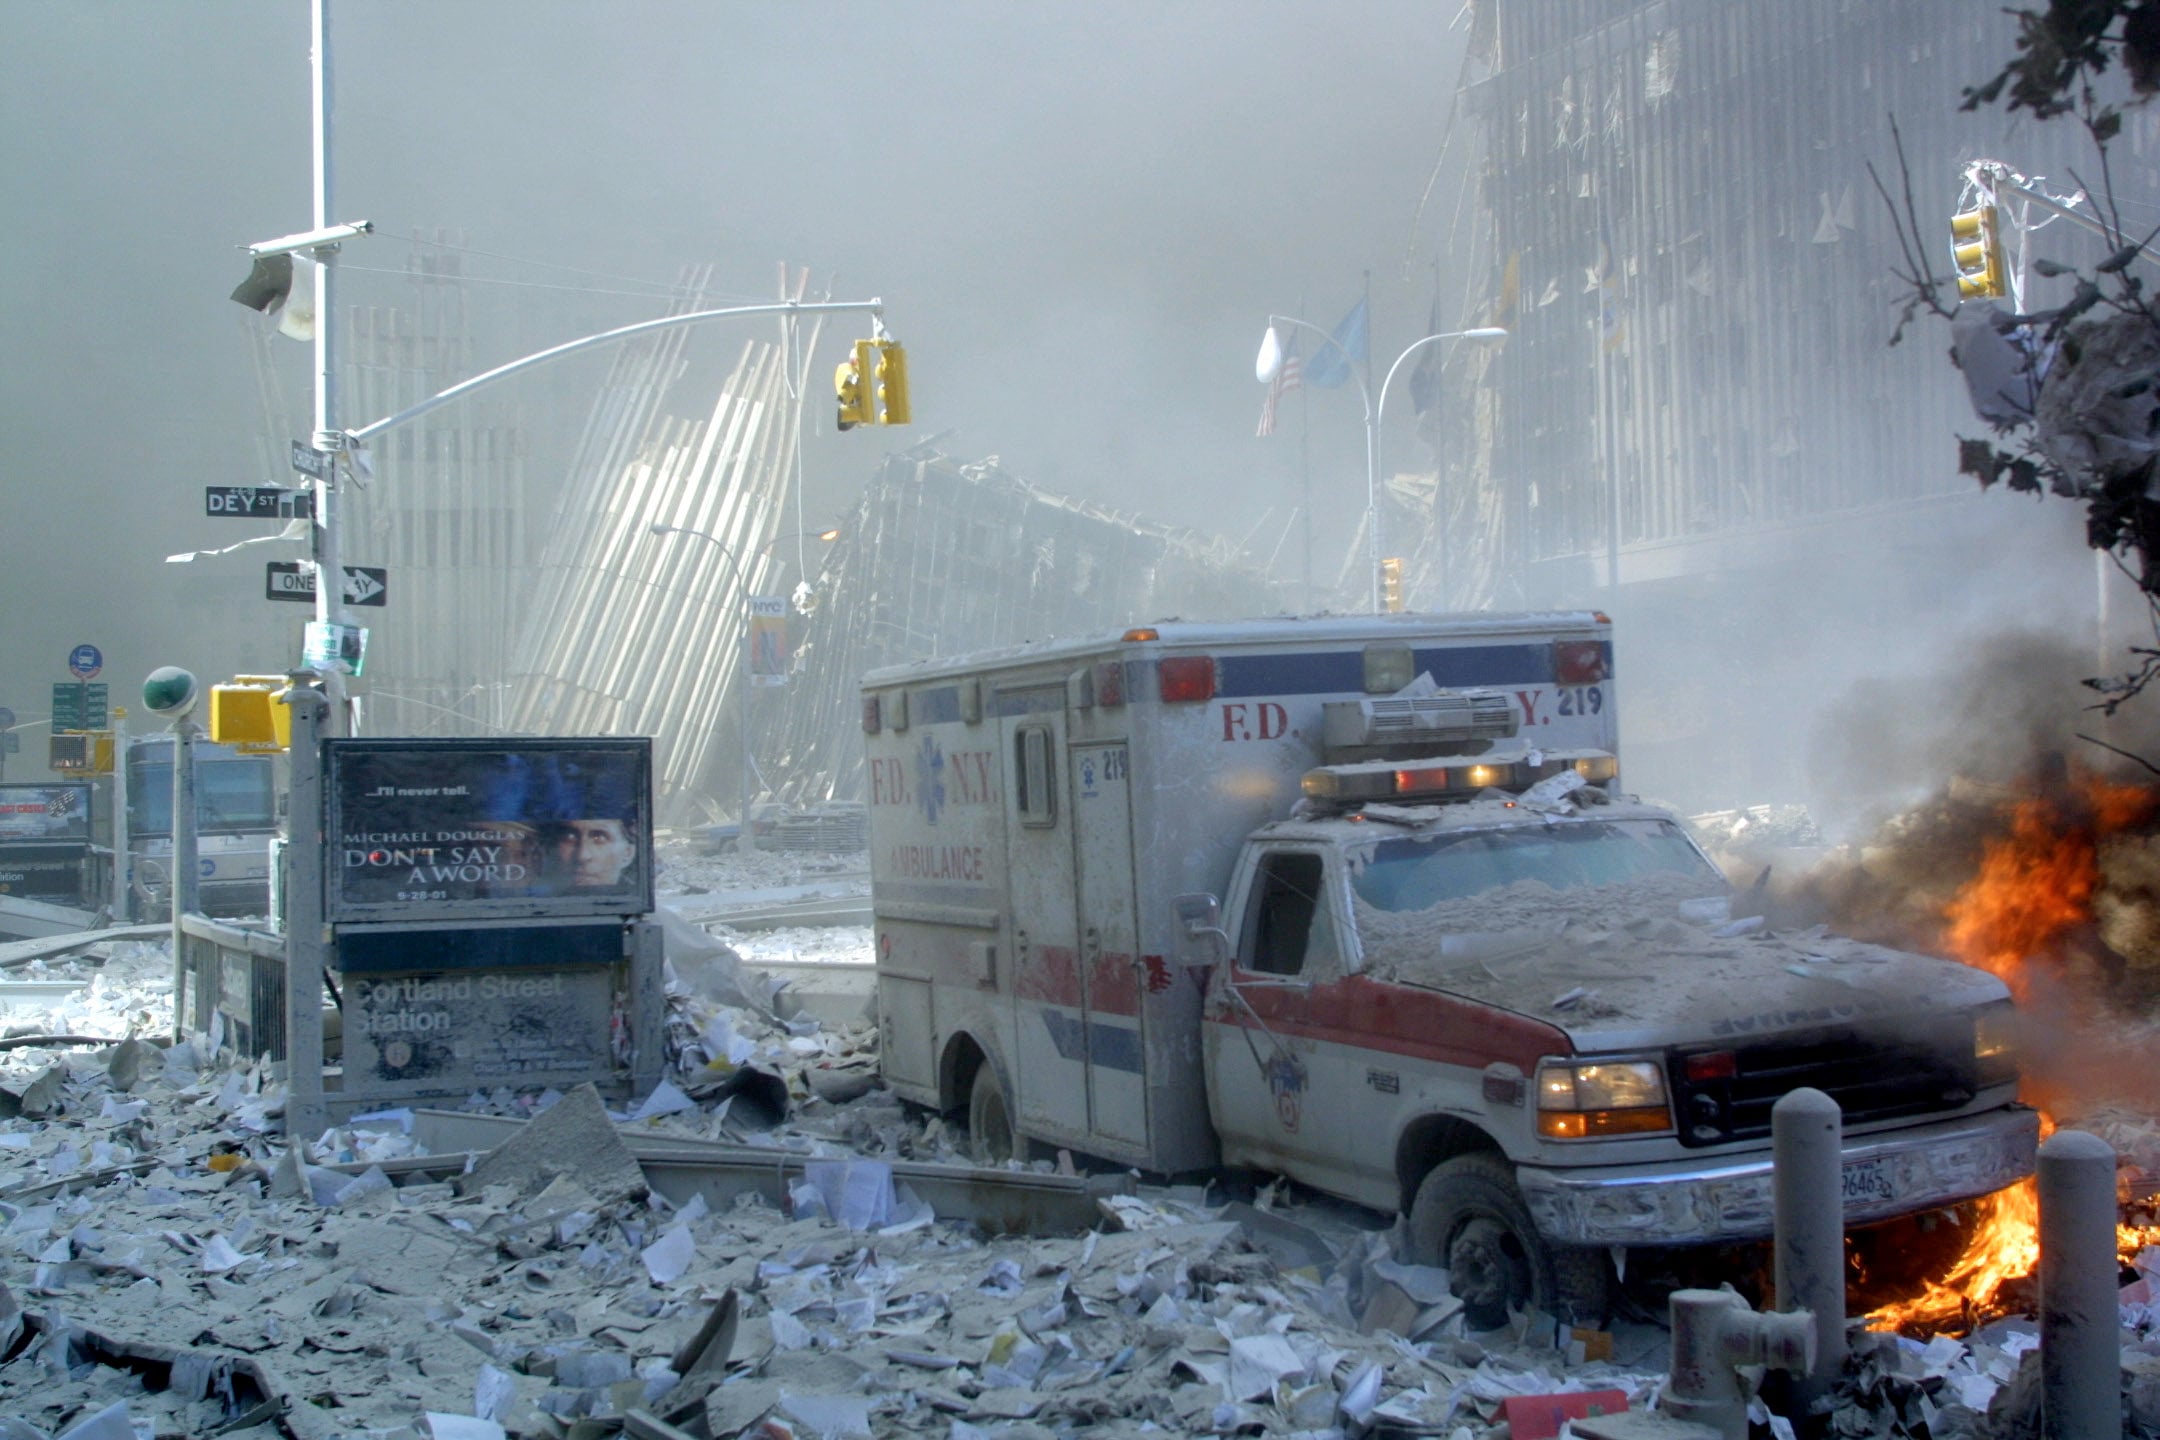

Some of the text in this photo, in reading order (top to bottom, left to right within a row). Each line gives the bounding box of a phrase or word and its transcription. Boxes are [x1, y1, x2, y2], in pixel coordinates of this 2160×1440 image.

[209, 494, 276, 512] DEY ST
[283, 574, 316, 591] ONE
[753, 601, 781, 613] NYC
[1221, 702, 1300, 742] F.D.
[1557, 686, 1602, 716] 219
[871, 751, 998, 805] F.D. N.Y.
[398, 787, 438, 797] never
[442, 785, 471, 796] tell.
[343, 830, 526, 844] MICHAEL DOUGLAS
[345, 846, 502, 868] DON'T SAY
[890, 845, 984, 881] AMBULANCE
[407, 864, 526, 885] A WORD
[397, 889, 447, 900] 9-28-01
[354, 973, 564, 1003] Cortland Street
[352, 1007, 450, 1033] Station
